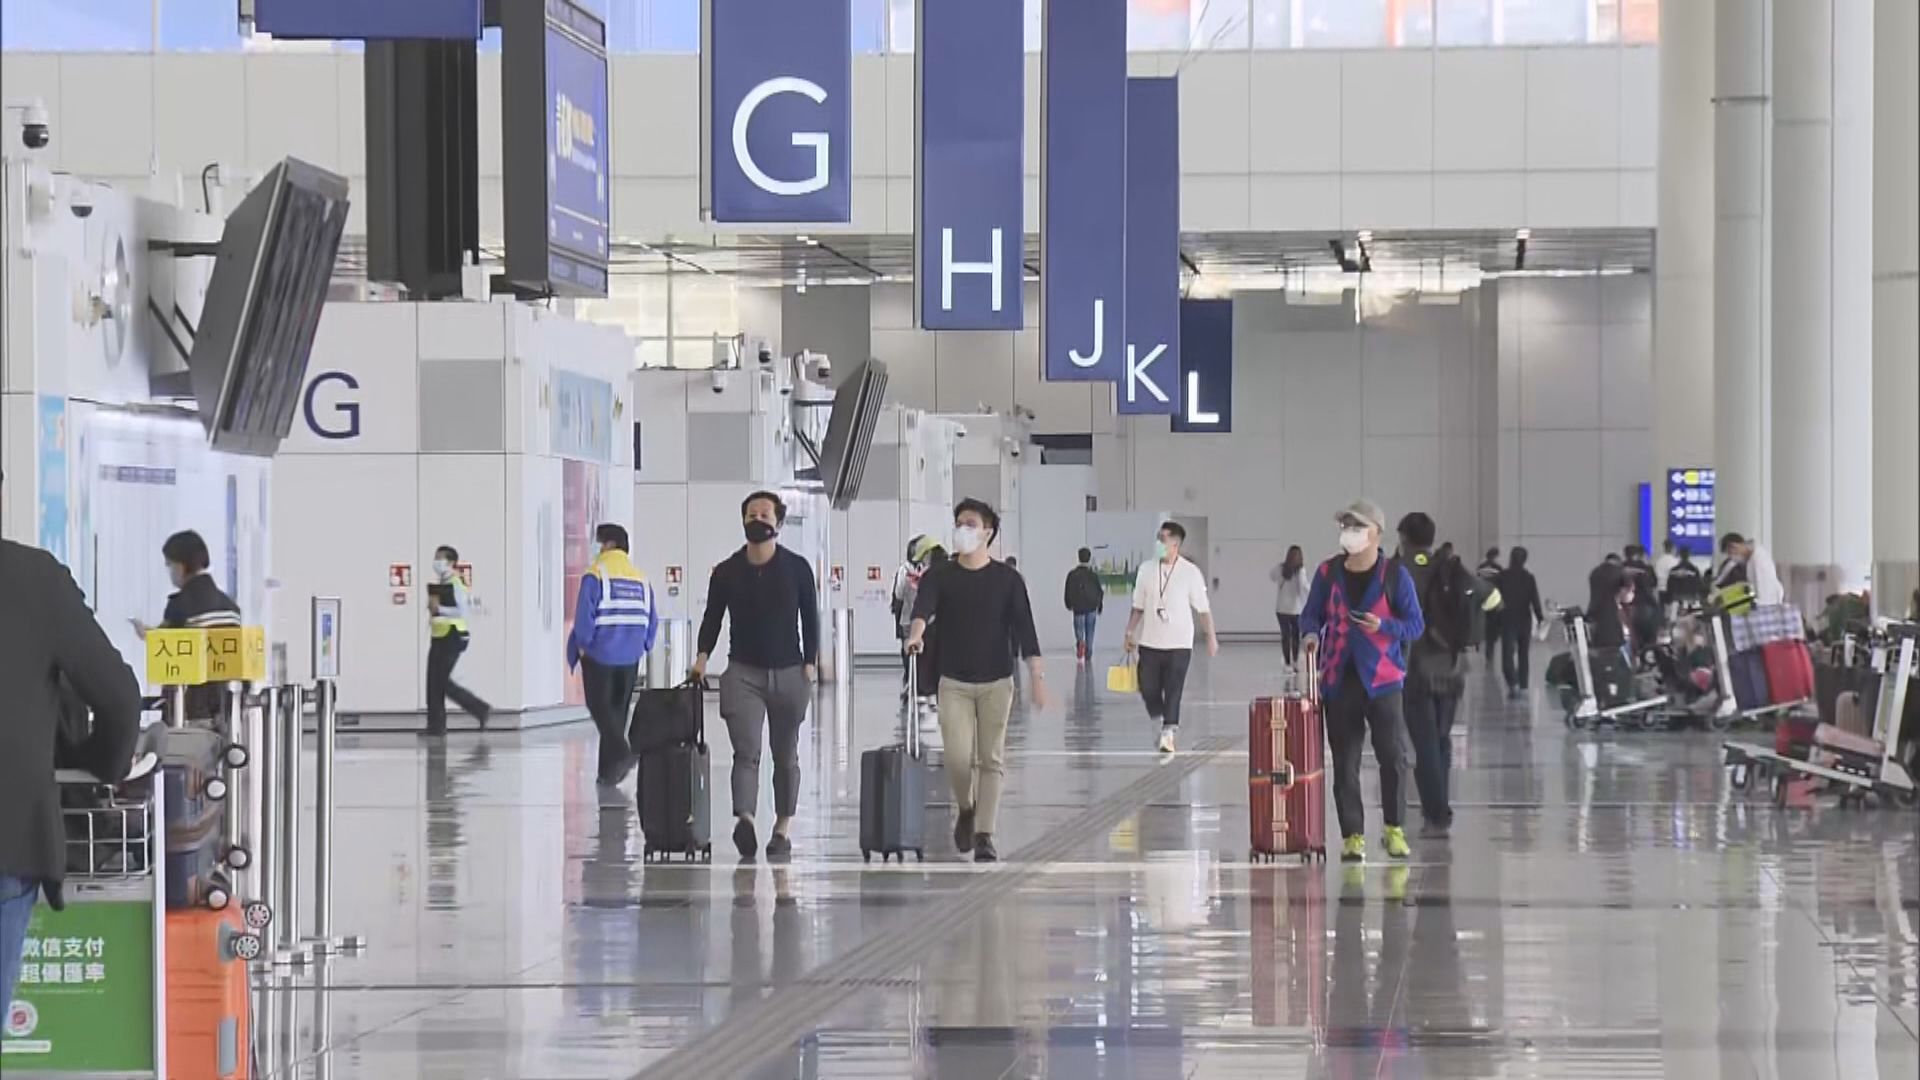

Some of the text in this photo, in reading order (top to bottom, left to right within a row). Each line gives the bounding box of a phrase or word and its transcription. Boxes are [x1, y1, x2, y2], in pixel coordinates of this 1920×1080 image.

[731, 76, 831, 196] G
[941, 228, 1003, 311] H
[1068, 299, 1104, 367] J
[1127, 343, 1170, 402] K
[1187, 371, 1220, 423] L
[303, 371, 361, 440] G
[154, 638, 193, 657] 入口
[165, 661, 181, 677] In
[206, 637, 238, 656] 入口
[212, 659, 226, 673] In
